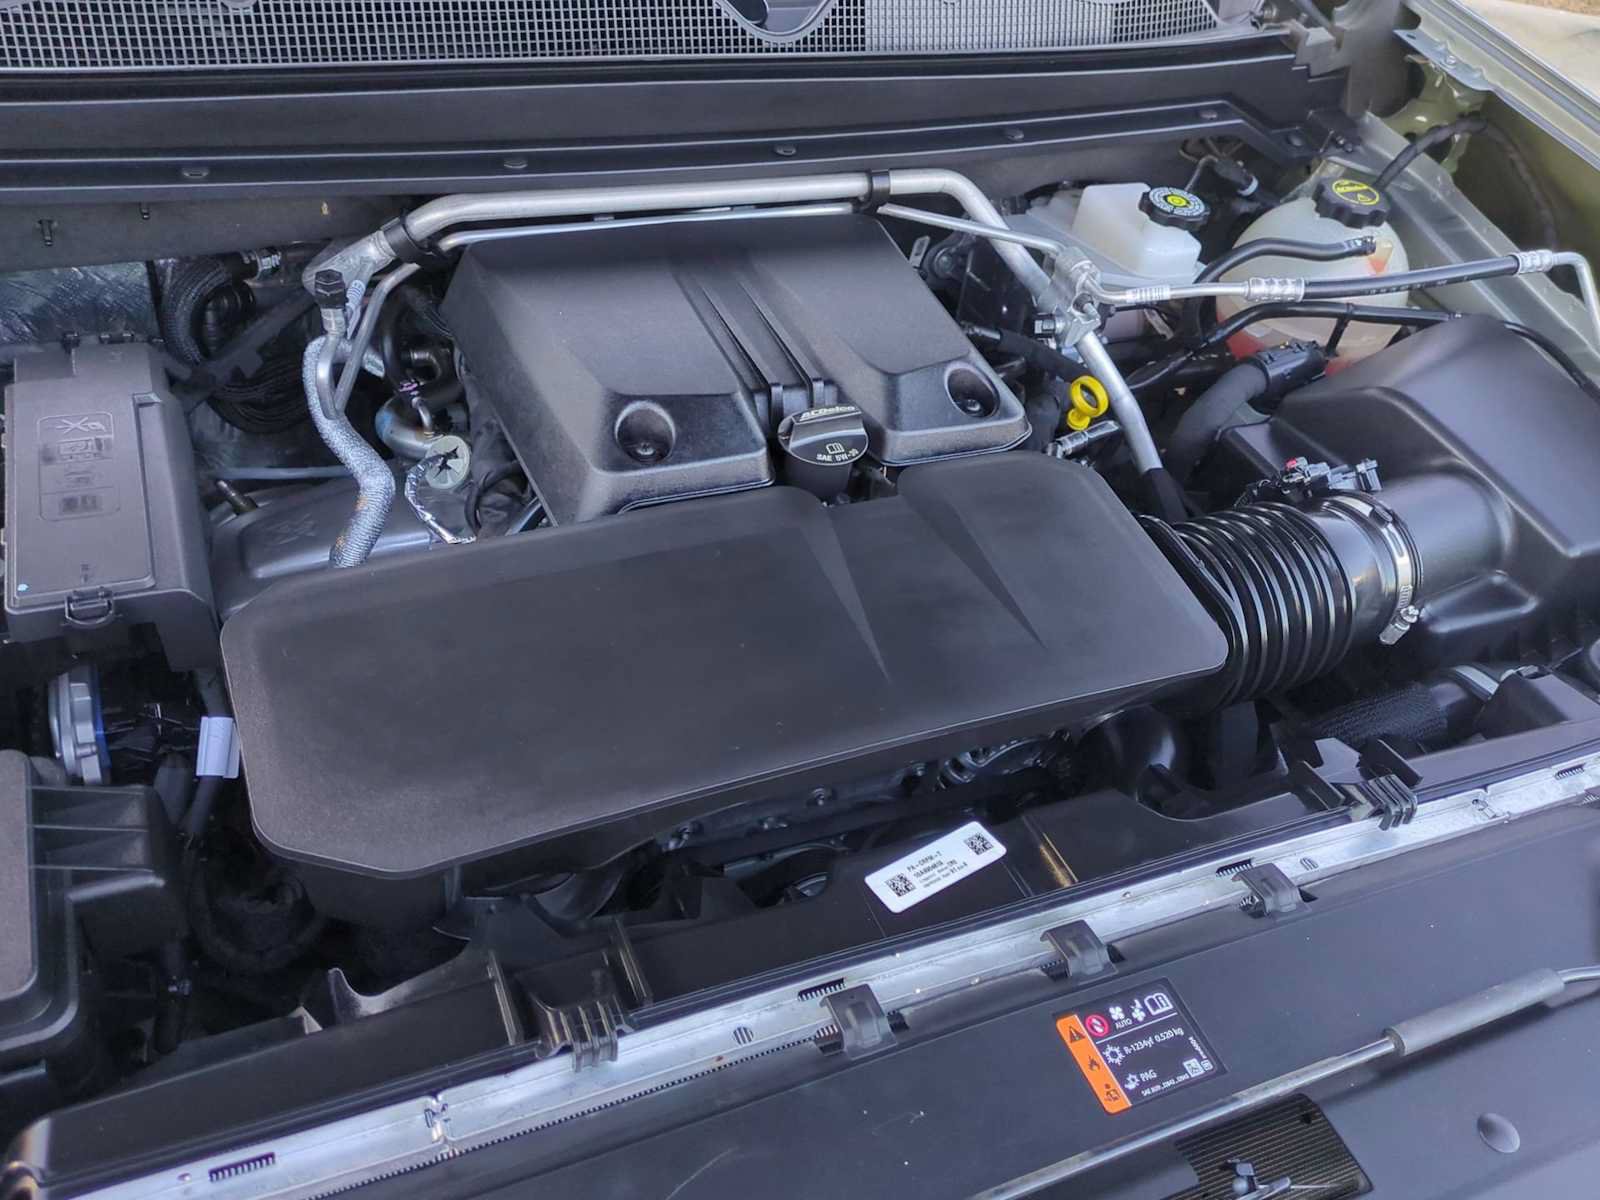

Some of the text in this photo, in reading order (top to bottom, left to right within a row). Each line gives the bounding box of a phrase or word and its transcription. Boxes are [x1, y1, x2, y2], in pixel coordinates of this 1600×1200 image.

[799, 406, 856, 421] ACDelco
[1115, 1018, 1133, 1030] AUTO
[1123, 1036, 1155, 1055] R-1234yf
[1172, 1027, 1184, 1036] kg
[1140, 1069, 1157, 1081] PAG
